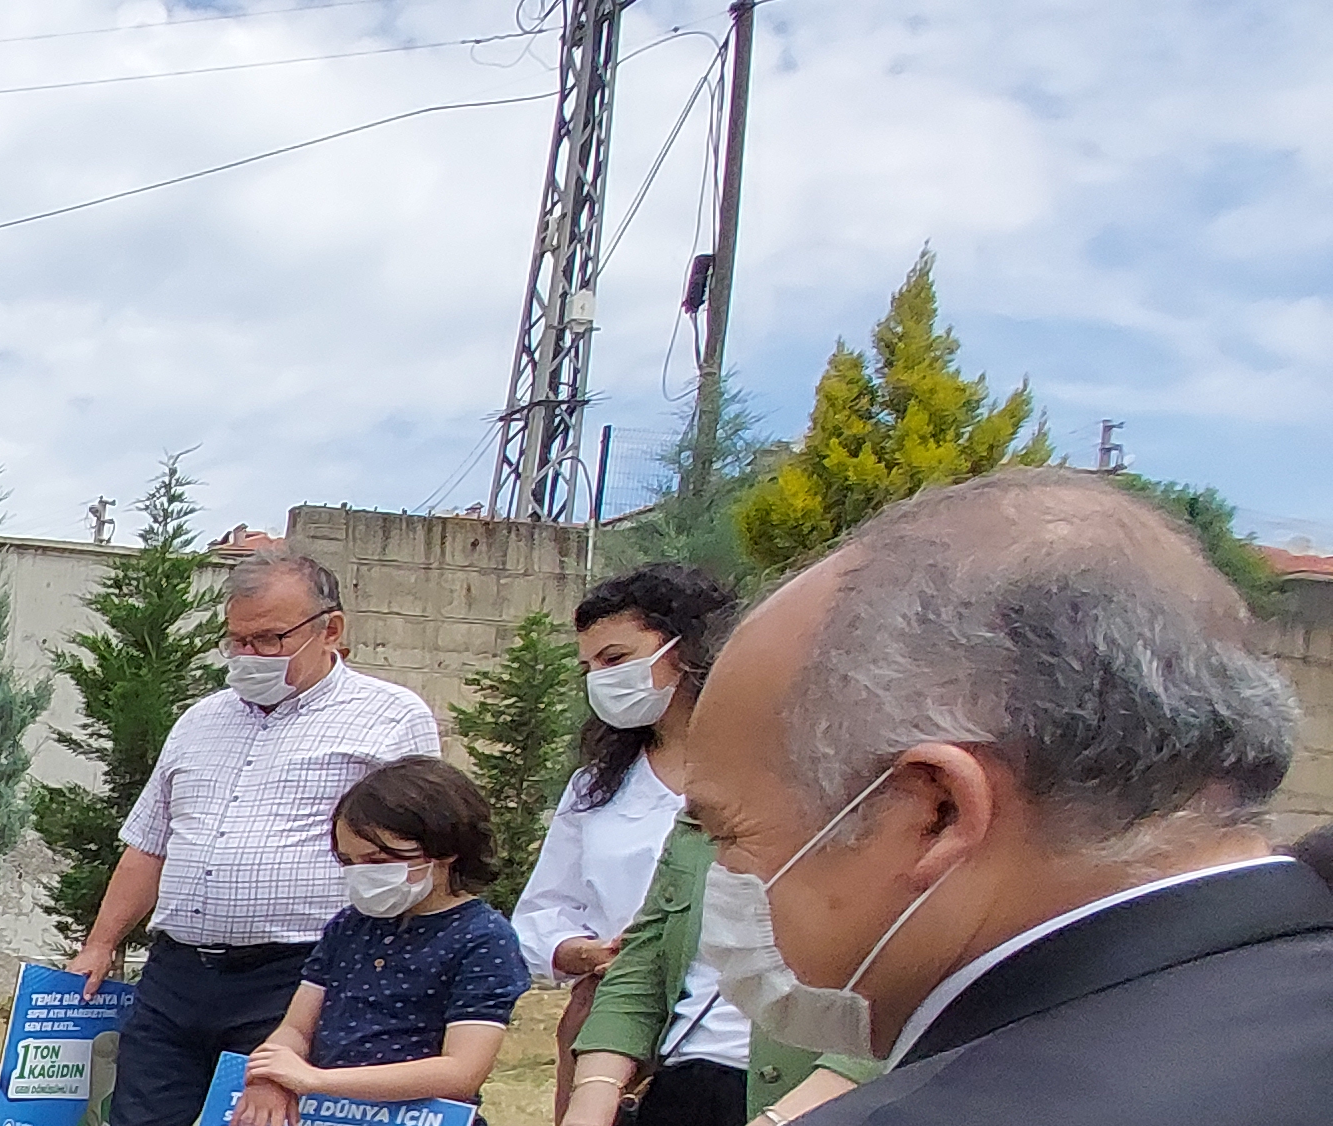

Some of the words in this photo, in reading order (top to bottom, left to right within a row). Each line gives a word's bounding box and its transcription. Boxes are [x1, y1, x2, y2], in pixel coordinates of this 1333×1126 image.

[15, 1044, 31, 1079] 1
[33, 1045, 61, 1060] TON
[27, 1061, 85, 1079] KAĞIDIN
[320, 1097, 389, 1123] DÜNYA
